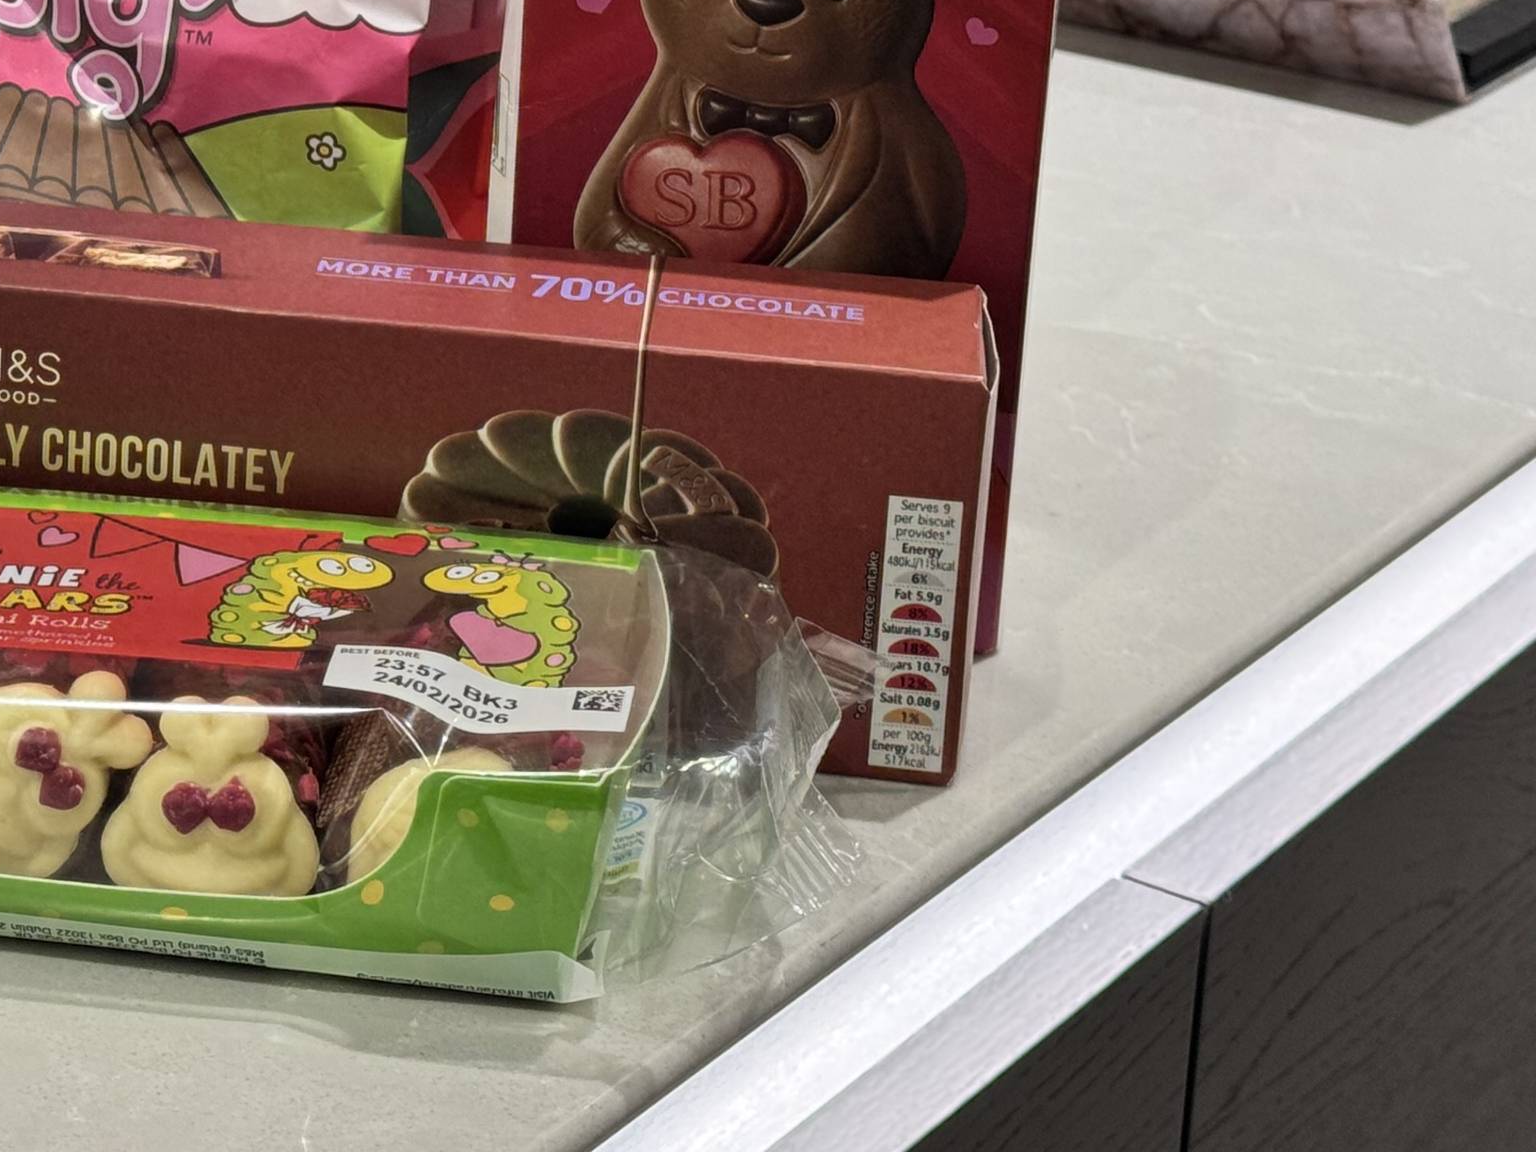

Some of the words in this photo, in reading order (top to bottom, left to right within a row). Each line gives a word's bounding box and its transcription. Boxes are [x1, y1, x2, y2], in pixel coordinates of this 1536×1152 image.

[654, 168, 758, 231] SB
[316, 259, 414, 281] MORE
[425, 268, 517, 290] THAN
[530, 274, 645, 306] 70%
[658, 288, 864, 322] CHOCOLATE
[41, 427, 296, 495] CHOCOLATEY
[901, 498, 939, 514] Serves
[943, 503, 952, 515] 9
[894, 514, 914, 526] per
[917, 514, 956, 528] biscuit
[901, 542, 944, 559] Energy
[95, 567, 142, 590] the
[911, 572, 929, 586] 6%
[894, 588, 915, 601] Fat
[915, 591, 943, 606] 5.9g
[28, 614, 112, 629] Rolls
[881, 622, 922, 637] Saturates
[924, 626, 950, 642] 3.5g
[340, 647, 370, 655] BEST
[373, 648, 421, 660] BEFORE
[375, 657, 448, 681] 23:57
[916, 661, 950, 677] 10.7g
[372, 671, 509, 725] 24/02/2026
[463, 684, 519, 710] BK3
[879, 692, 903, 705] Salt
[906, 695, 941, 710] 0.08g
[882, 729, 901, 740] per
[906, 730, 932, 743] 100g
[872, 738, 908, 755] Energy
[884, 753, 926, 769] 517kcal
